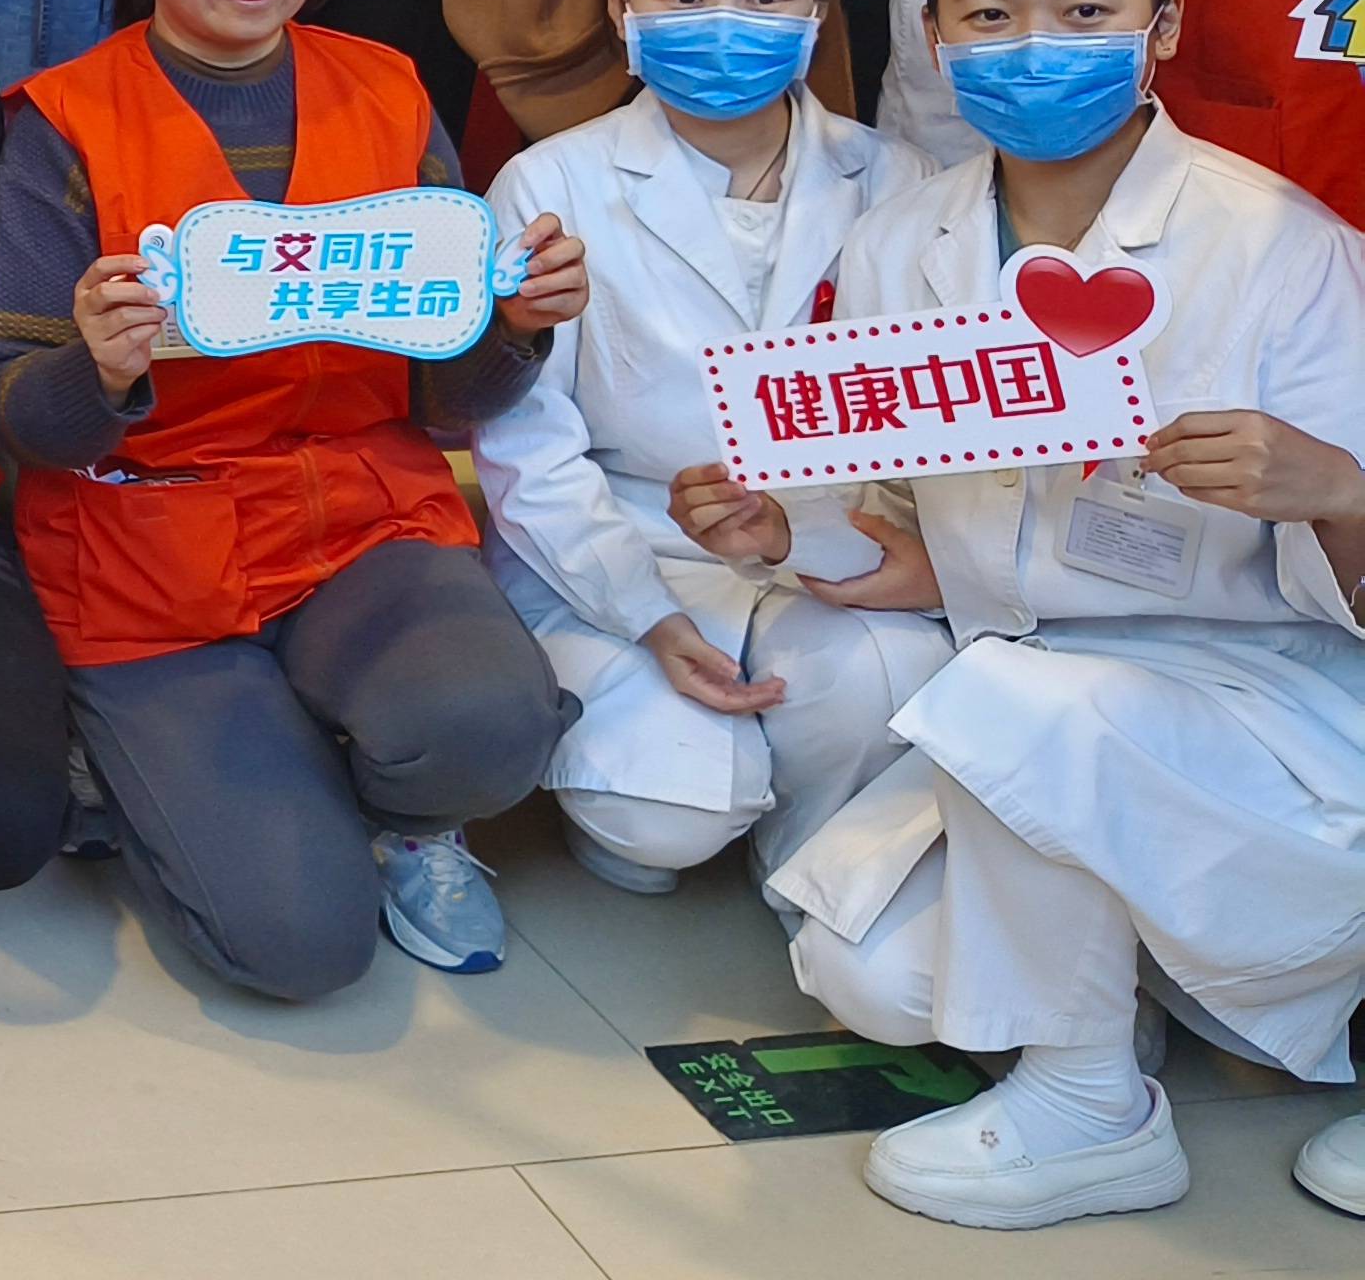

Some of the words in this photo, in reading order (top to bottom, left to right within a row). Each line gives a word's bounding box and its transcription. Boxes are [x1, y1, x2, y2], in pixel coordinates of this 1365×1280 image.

[220, 231, 414, 273] 与艾同行
[269, 280, 463, 321] 共享生命
[754, 342, 1067, 442] 健康中国
[679, 1061, 753, 1120] EXIT
